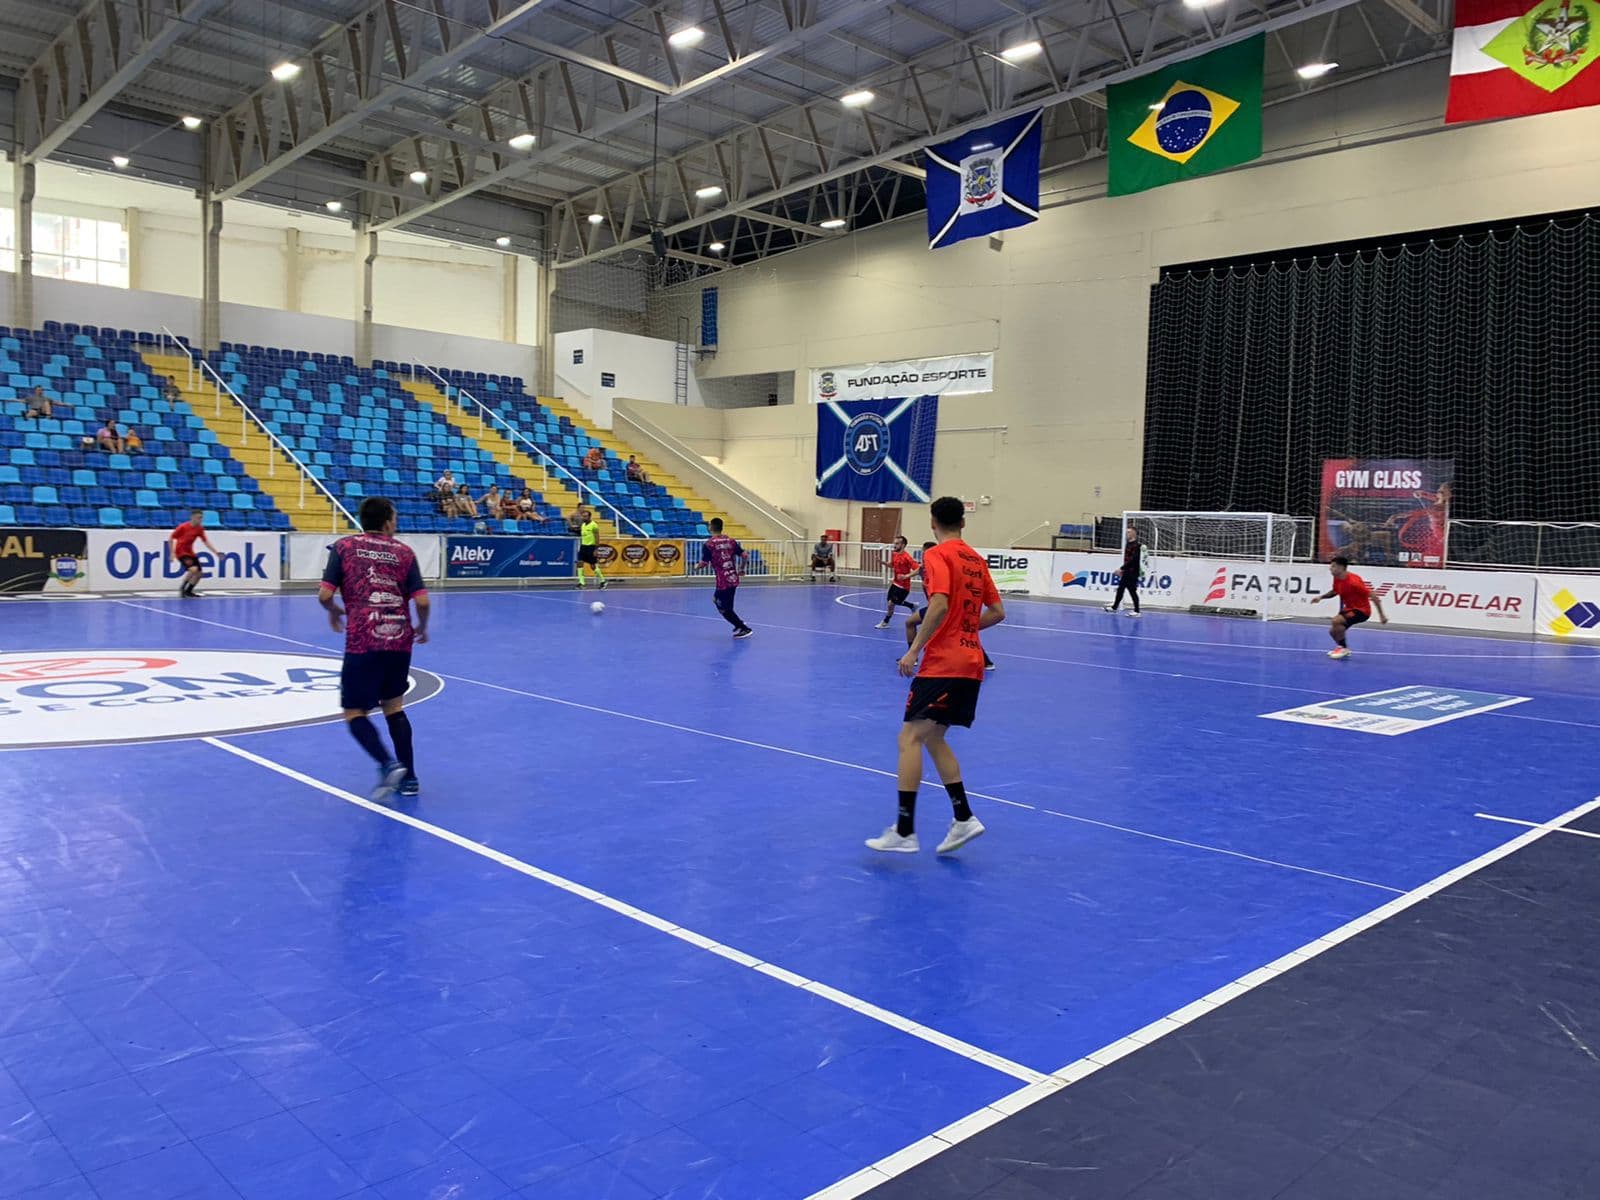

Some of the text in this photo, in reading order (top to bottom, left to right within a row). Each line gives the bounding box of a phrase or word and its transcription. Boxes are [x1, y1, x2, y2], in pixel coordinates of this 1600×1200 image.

[847, 368, 987, 388] FUNDAÇÃO ESPORTE
[1335, 470, 1422, 489] GYM CLASS
[0, 535, 45, 558] AL
[450, 545, 495, 561] Ateky
[105, 540, 269, 580] Orbenk
[987, 554, 1029, 569] Elite
[1090, 570, 1172, 590] TUBRÃO
[1231, 574, 1321, 595] FAROL
[1231, 593, 1307, 603] SHOPPIN
[1393, 590, 1522, 612] VENDELAR
